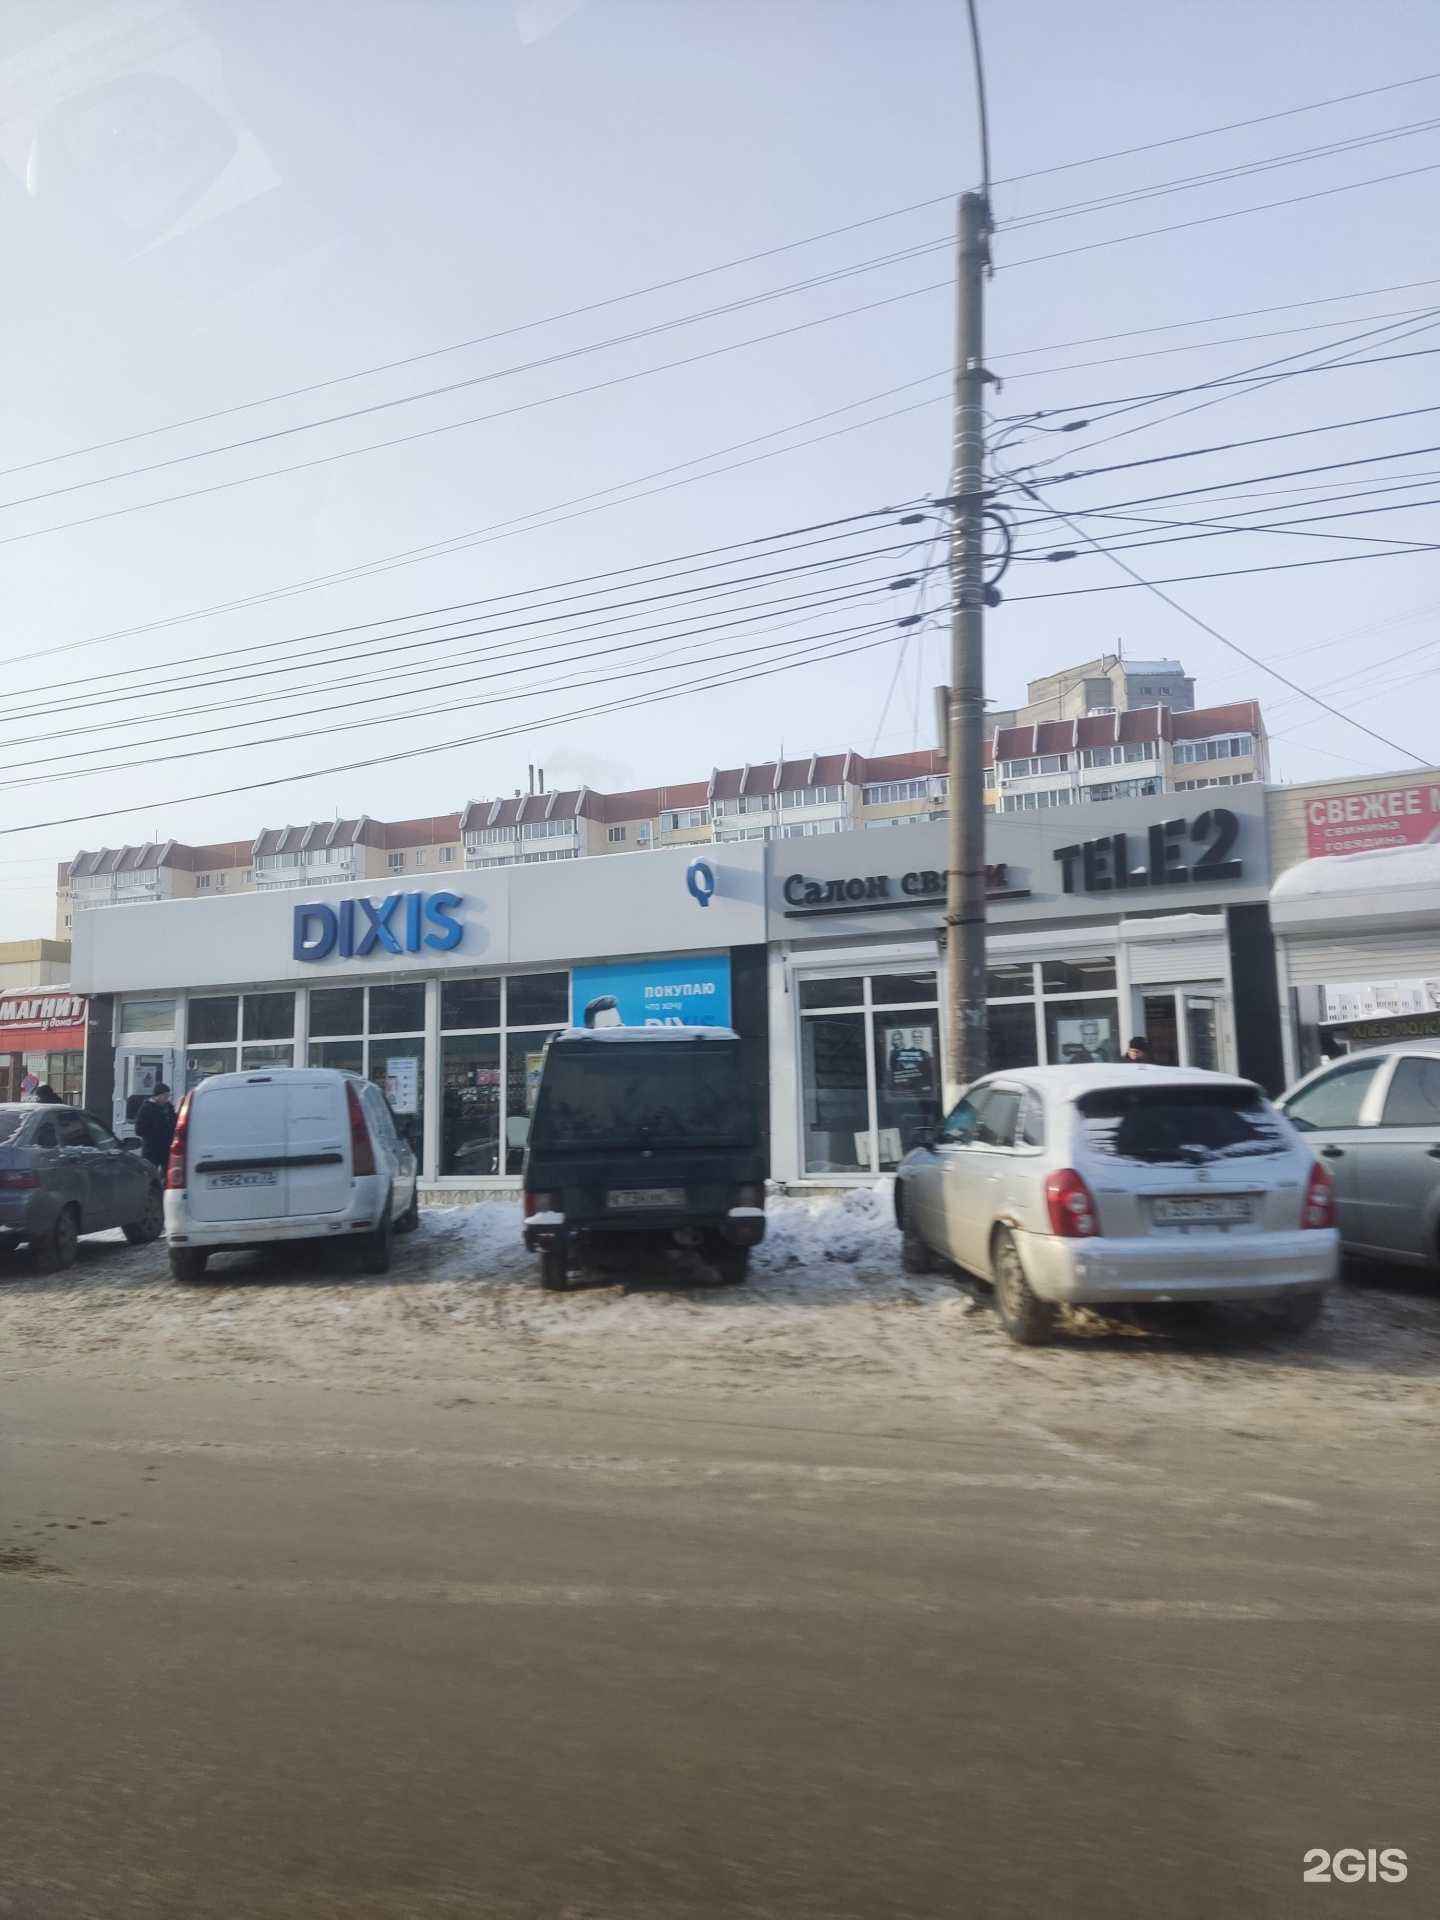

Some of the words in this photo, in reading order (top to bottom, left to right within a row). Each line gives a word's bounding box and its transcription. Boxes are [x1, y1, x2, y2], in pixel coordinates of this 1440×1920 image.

[1309, 790, 1424, 826] СВЕЖЕЕ
[1053, 808, 1243, 894] TELE2
[783, 873, 889, 905] Салон
[901, 863, 1008, 896] сви
[293, 890, 463, 961] DIXIS
[644, 982, 716, 998] ПОКУПАЮ
